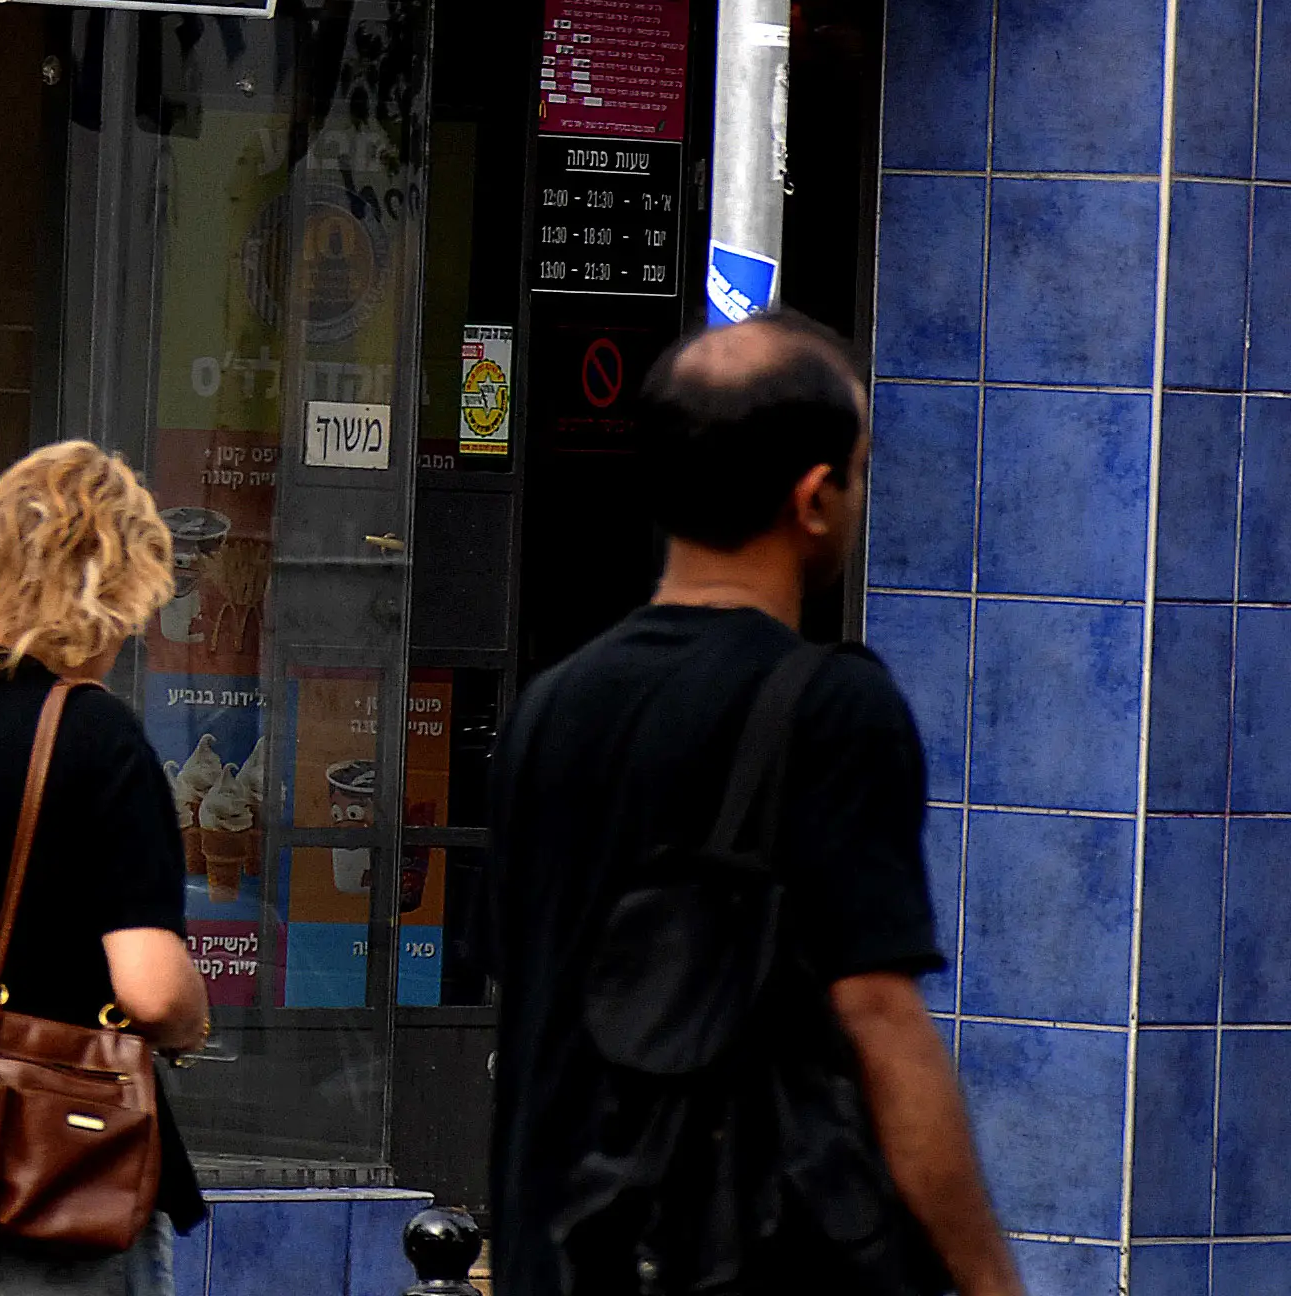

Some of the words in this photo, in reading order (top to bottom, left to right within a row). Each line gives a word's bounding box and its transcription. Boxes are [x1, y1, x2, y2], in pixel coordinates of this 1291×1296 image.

[567, 149, 609, 168] פתיחה
[614, 151, 650, 171] שעות
[542, 188, 569, 207] 12:00
[586, 190, 614, 208] 21:30
[541, 225, 568, 244] 11:30
[540, 261, 566, 280] 13:00
[584, 262, 611, 280] 21:30
[642, 264, 666, 283] שבת
[317, 412, 382, 461] משוך
